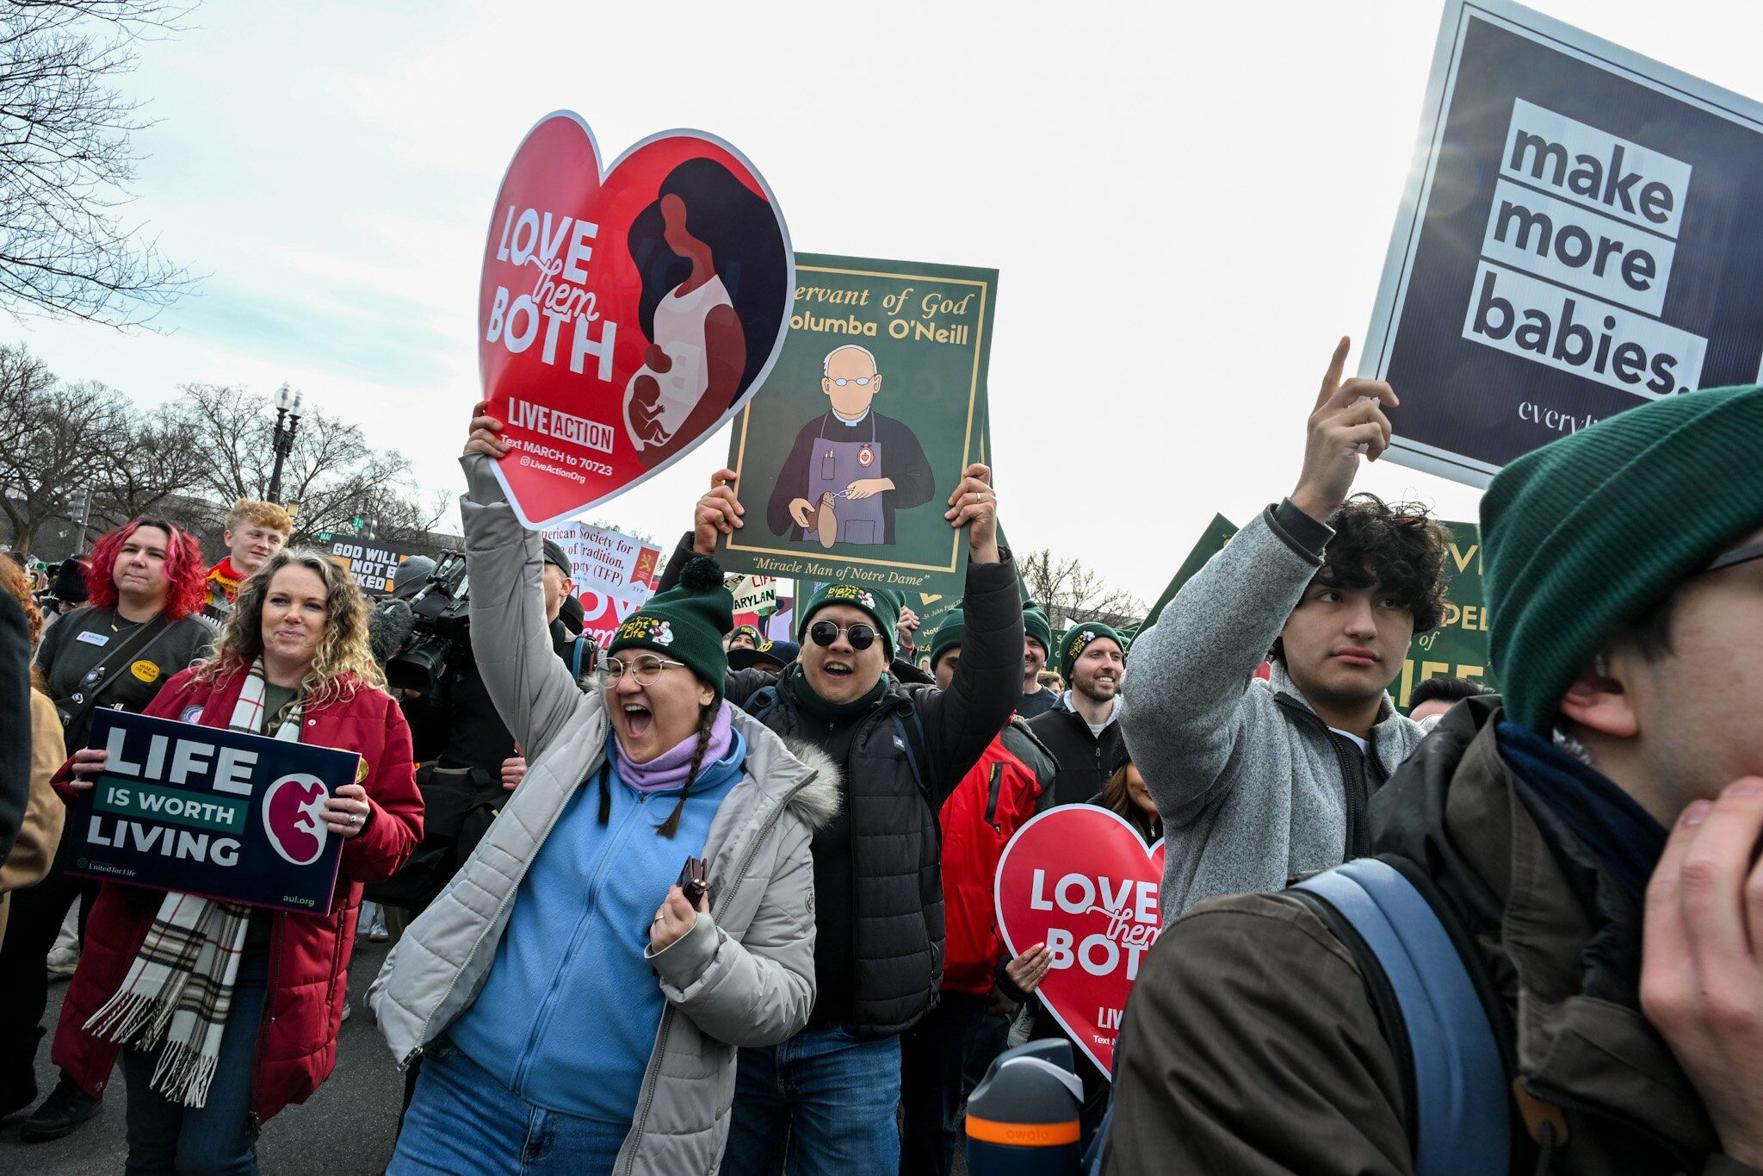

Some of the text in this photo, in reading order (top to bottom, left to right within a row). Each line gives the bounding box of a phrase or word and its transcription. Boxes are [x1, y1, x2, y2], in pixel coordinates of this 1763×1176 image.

[1510, 129, 1674, 224] make
[496, 205, 598, 286] LOVE
[1494, 200, 1656, 291] more
[525, 254, 599, 322] them
[793, 285, 975, 320] ervant of God
[486, 286, 617, 382] BOTH
[789, 311, 968, 345] olumba O'Neill
[1472, 270, 1690, 396] babies.
[508, 396, 613, 452] LIVE ACTION
[500, 434, 613, 476] Text MARCH to 70723
[332, 543, 398, 565] GOD WILL
[568, 543, 578, 553] of
[580, 527, 614, 549] Society
[616, 540, 633, 555] for
[351, 559, 384, 576] NOT
[593, 564, 624, 587] (TFP)
[804, 563, 833, 576] Man
[836, 566, 850, 580] of
[850, 568, 885, 582] Notre
[734, 589, 776, 609] ARYLAN
[1418, 631, 1440, 651] of
[105, 726, 258, 796] LIFE
[107, 787, 235, 825] IS WORTH
[87, 815, 241, 867] LIVING
[283, 895, 315, 908] aul.org
[1030, 869, 1158, 924] LOVE
[1046, 927, 1149, 981] BOT
[1097, 1006, 1123, 1030] LIV
[1093, 1034, 1110, 1045] Text
